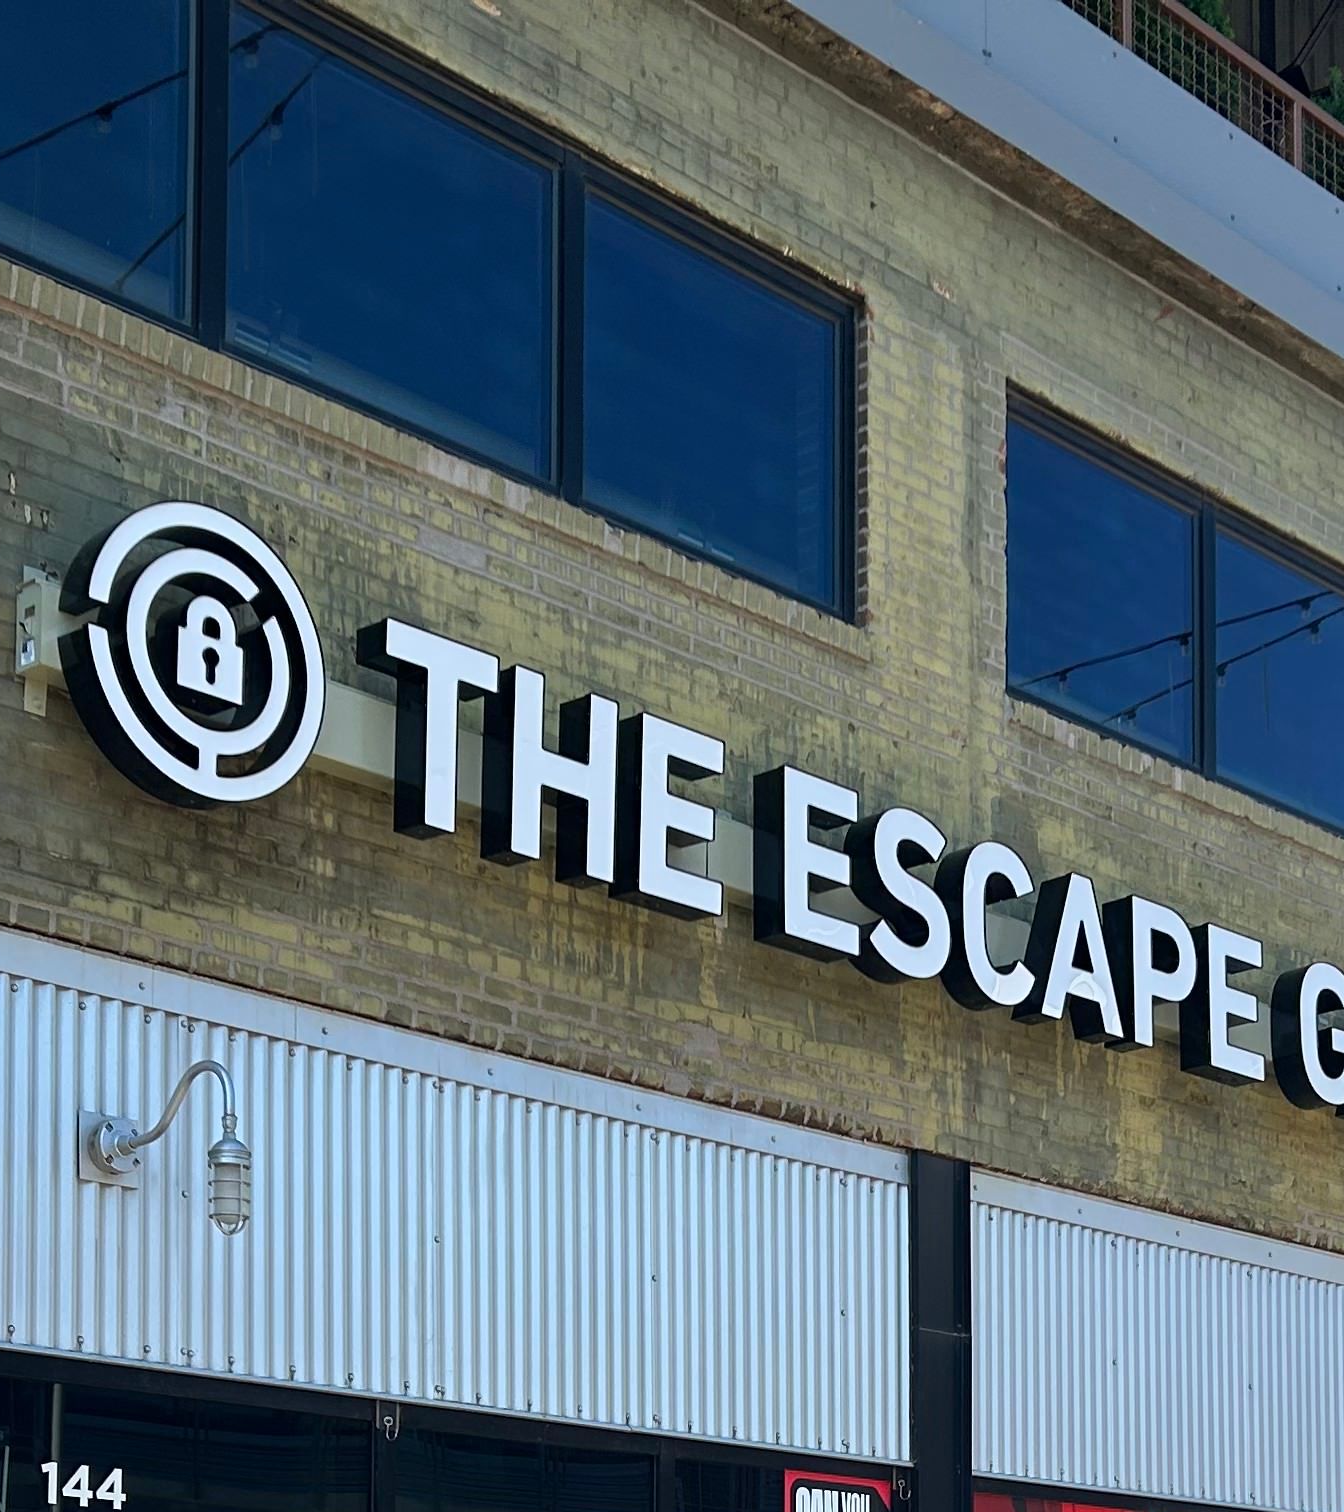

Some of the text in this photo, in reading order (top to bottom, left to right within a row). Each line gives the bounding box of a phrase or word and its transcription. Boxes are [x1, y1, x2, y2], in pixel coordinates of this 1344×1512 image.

[384, 616, 724, 917] THE
[784, 764, 1265, 1083] ESCAPE
[41, 1461, 127, 1510] 144
